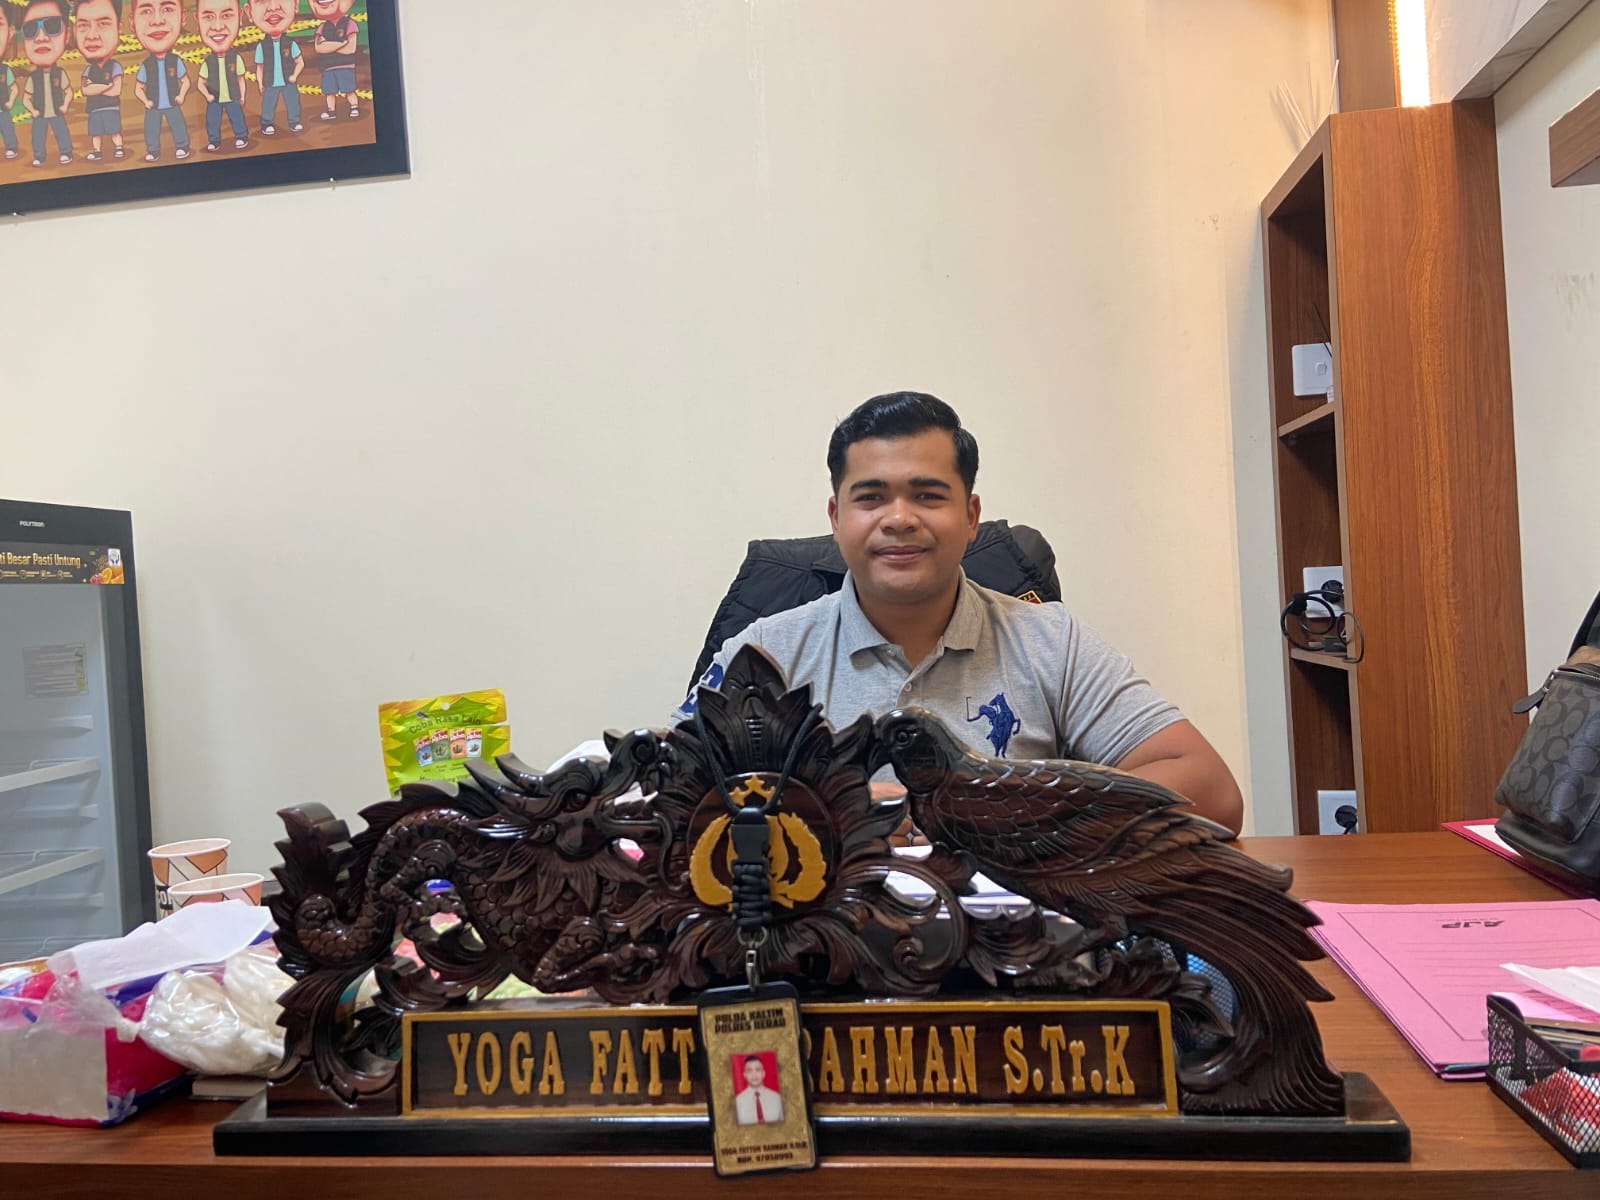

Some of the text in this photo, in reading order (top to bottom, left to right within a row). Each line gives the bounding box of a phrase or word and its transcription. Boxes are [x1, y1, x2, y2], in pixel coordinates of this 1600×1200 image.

[7, 552, 31, 565] Besar
[32, 552, 53, 566] Pasti
[54, 553, 81, 569] Untung
[409, 713, 481, 734] Coba Rasa Lain
[715, 1008, 783, 1023] POLDA KALTIM
[715, 1018, 786, 1034] POLRES BERAU
[447, 1030, 565, 1096] YOGA
[589, 1028, 696, 1096] FATT
[1003, 1024, 1136, 1096] S.Tr.K
